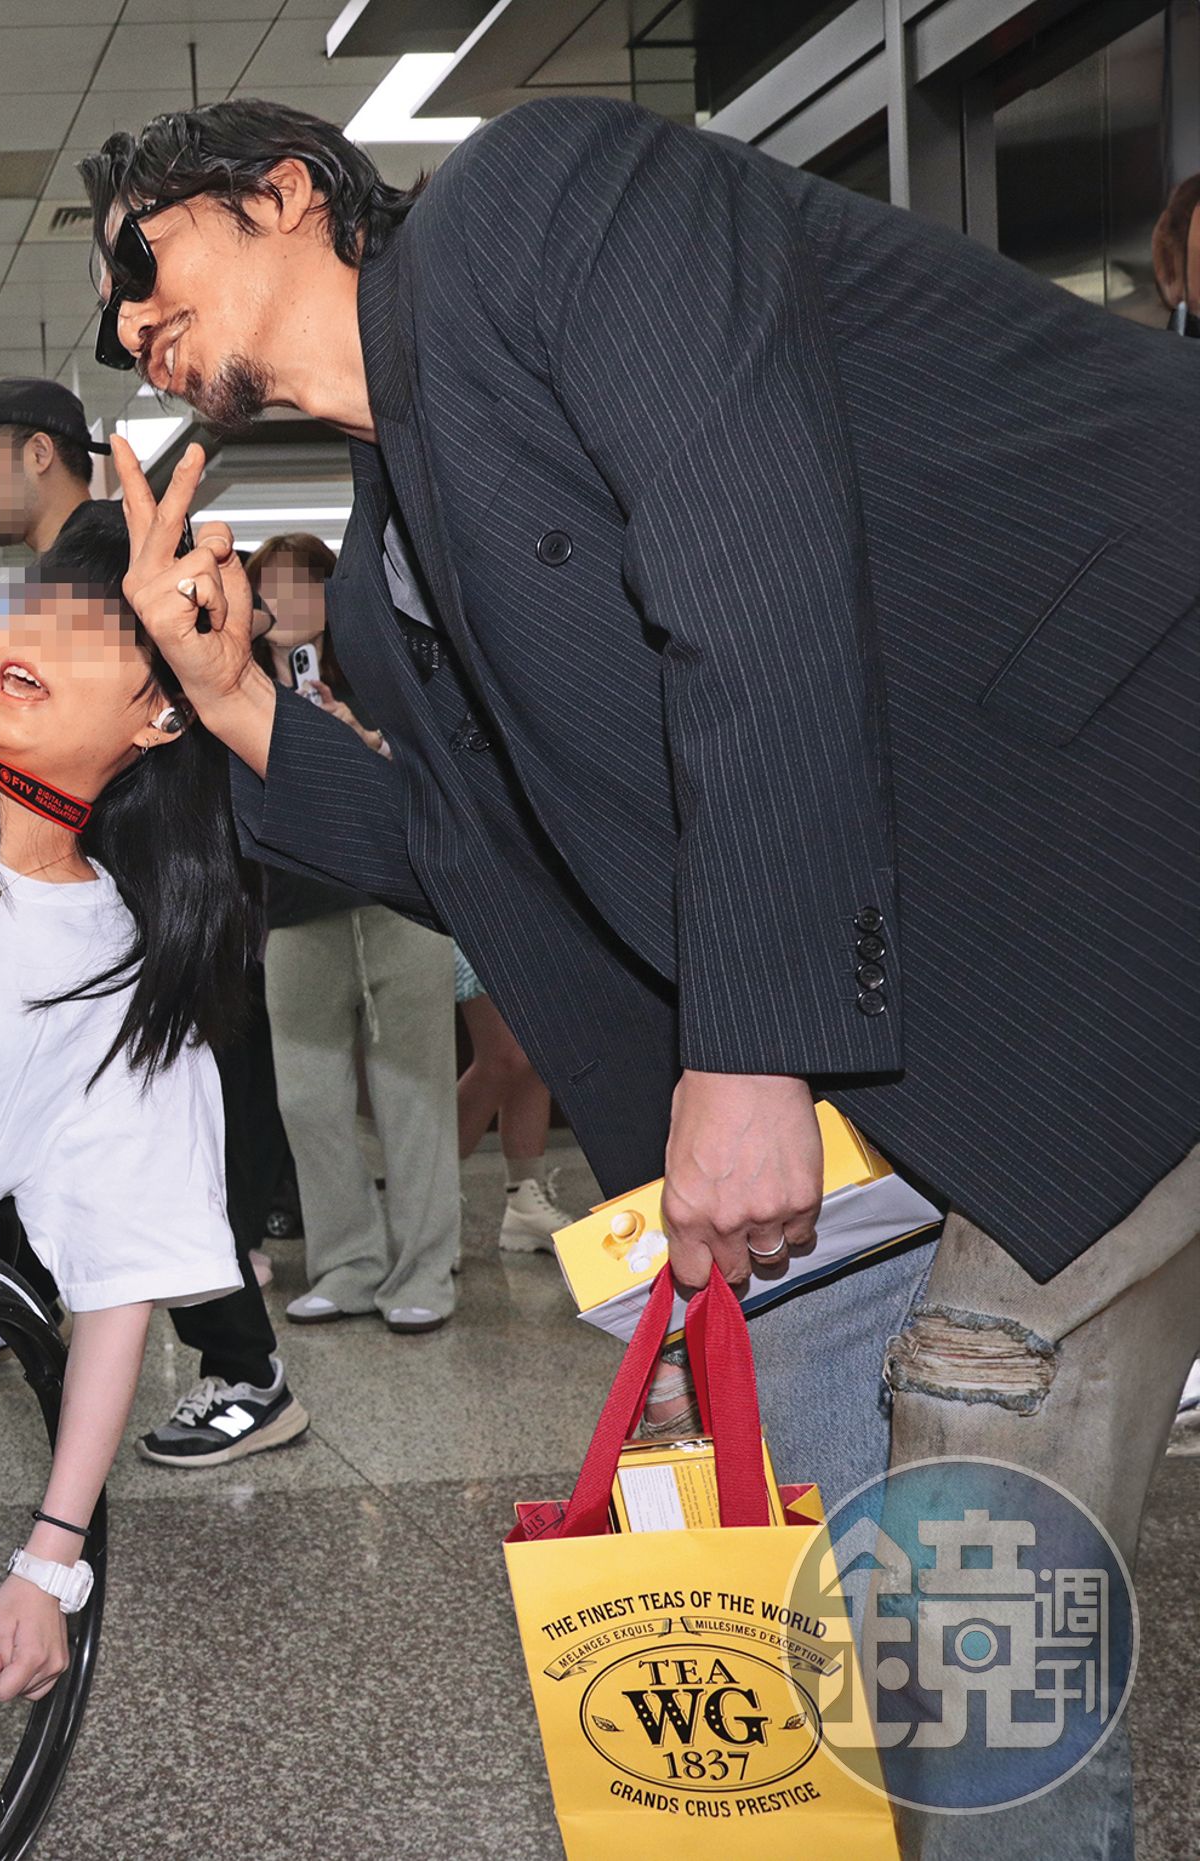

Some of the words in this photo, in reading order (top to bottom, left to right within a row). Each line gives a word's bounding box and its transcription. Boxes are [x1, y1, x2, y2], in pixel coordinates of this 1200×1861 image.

[11, 775, 34, 795] FTV
[542, 1615, 578, 1642] THE
[575, 1597, 636, 1634] FINEST
[638, 1590, 686, 1611] TEAS
[690, 1590, 713, 1608] OF
[717, 1593, 755, 1615] THE
[760, 1600, 828, 1640] WORLD
[612, 1623, 655, 1640] EXQUIS
[638, 1658, 740, 1686] TEA
[621, 1686, 773, 1748] WG
[662, 1749, 750, 1781] 1837
[610, 1780, 679, 1814] GRANDS
[685, 1799, 732, 1818] CRUS
[738, 1781, 821, 1817] PRESTIGE
